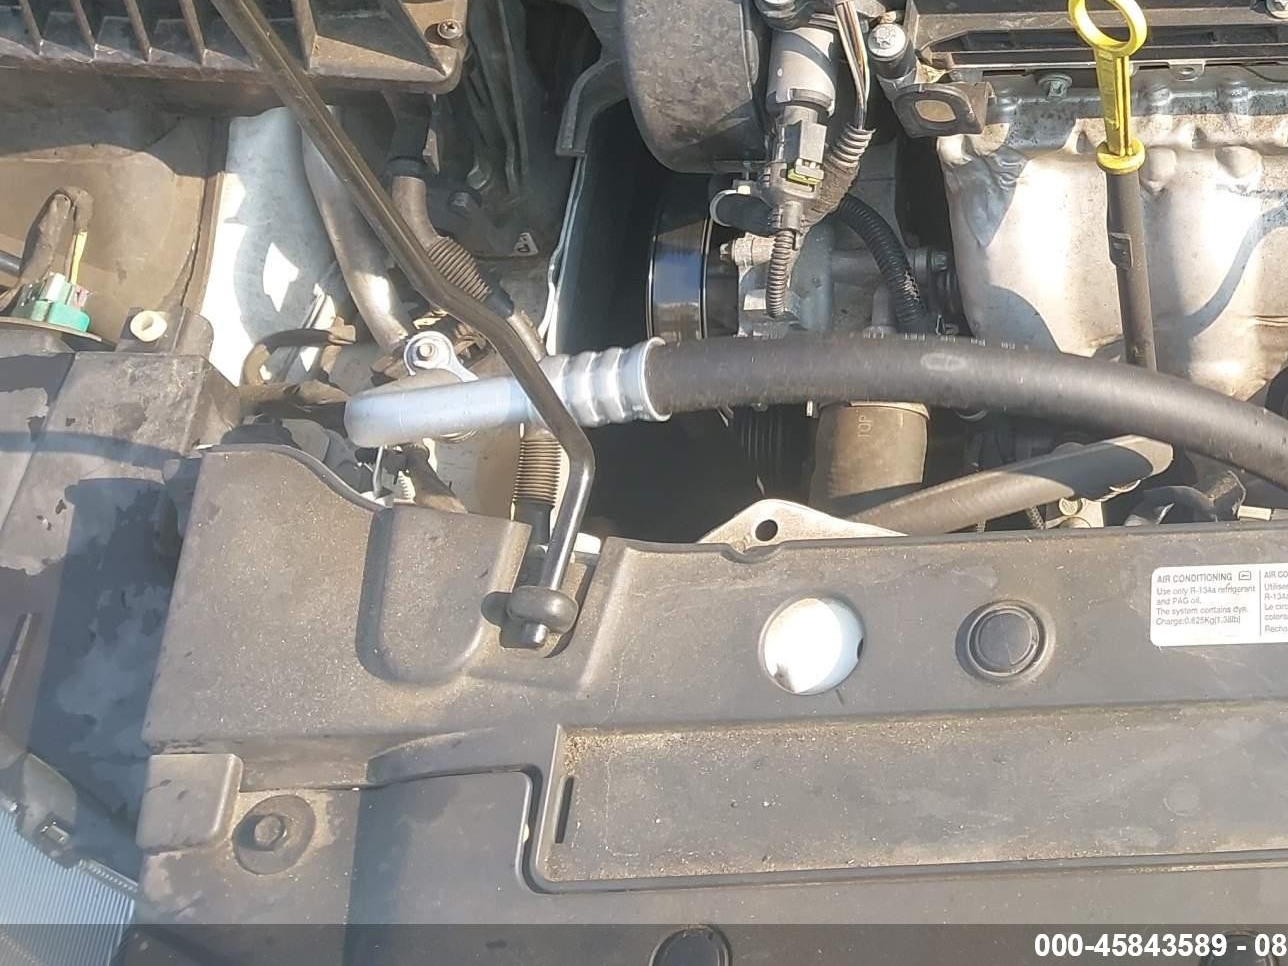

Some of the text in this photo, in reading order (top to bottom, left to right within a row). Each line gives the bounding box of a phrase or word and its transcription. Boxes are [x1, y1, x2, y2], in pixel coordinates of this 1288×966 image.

[1157, 573, 1232, 583] AIR CONDITIONING
[1264, 570, 1276, 578] AIR
[1173, 588, 1188, 596] only
[1190, 586, 1216, 594] R-134a
[1218, 585, 1256, 595] refrigerant
[1264, 583, 1288, 591] Utiliser
[1156, 607, 1170, 615] The
[1171, 608, 1198, 616] system
[1200, 606, 1231, 614] contains
[1264, 603, 1273, 611] Le
